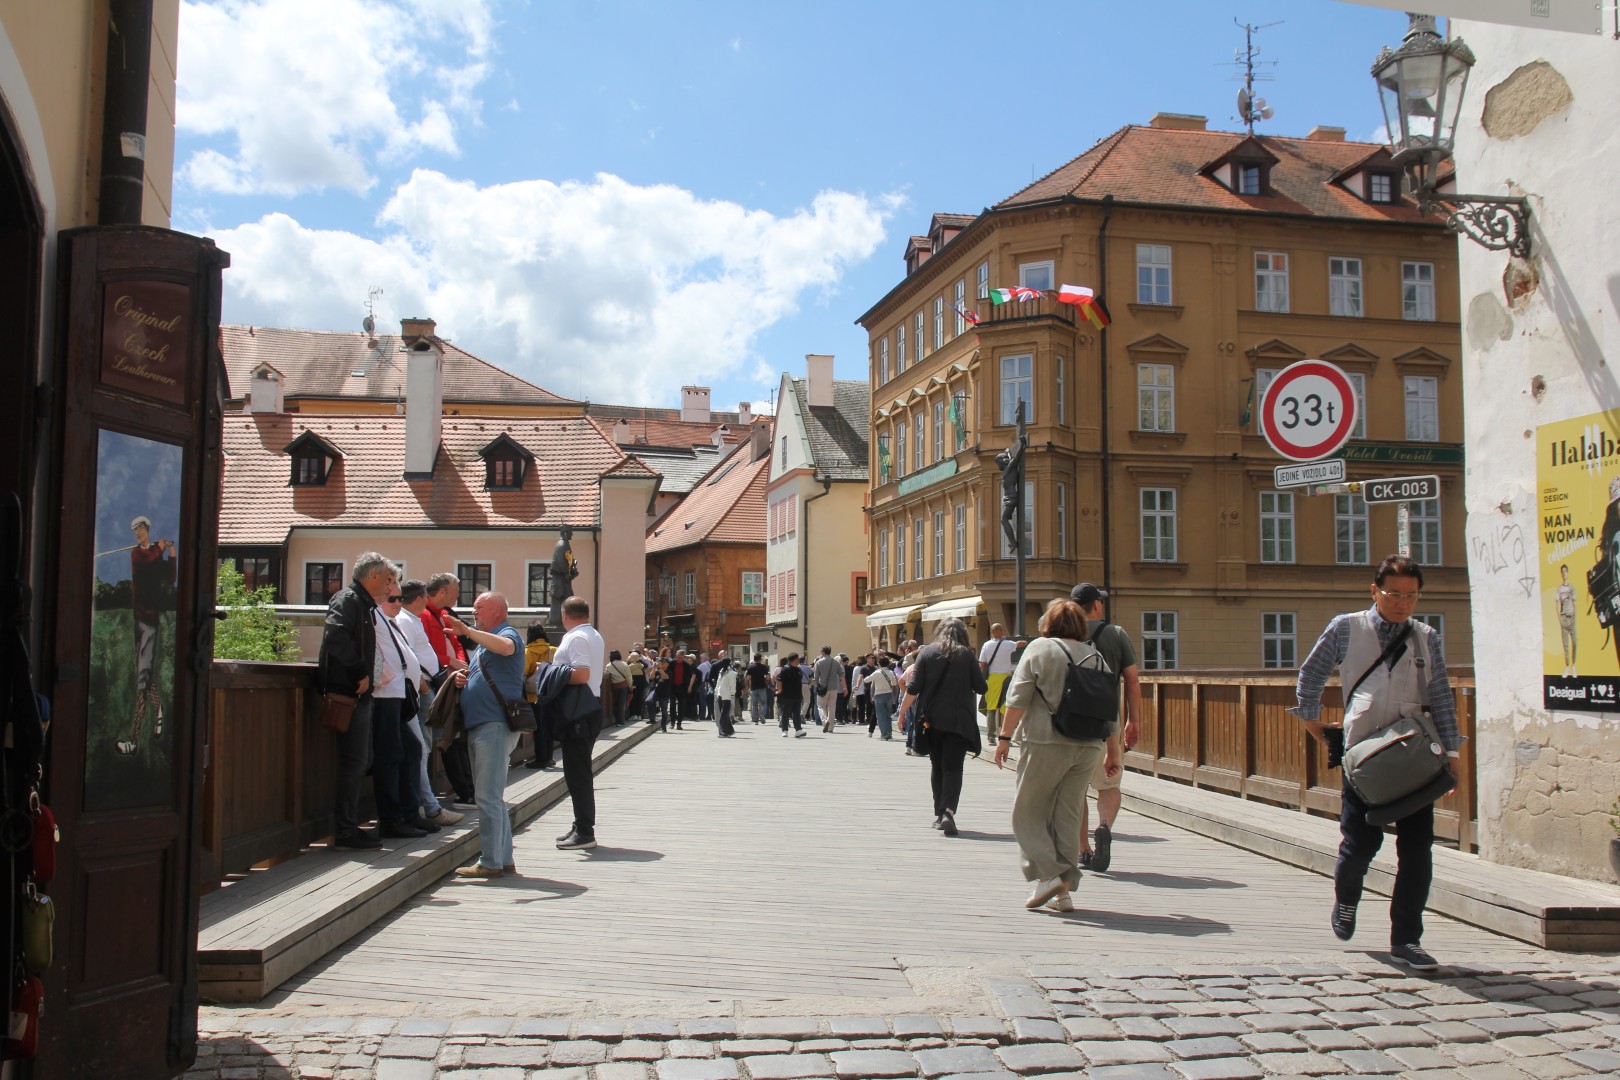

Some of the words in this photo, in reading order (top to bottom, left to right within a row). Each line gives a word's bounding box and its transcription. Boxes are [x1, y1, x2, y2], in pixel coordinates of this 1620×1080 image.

[114, 295, 182, 333] Original
[123, 330, 170, 363] Czech
[111, 354, 177, 386] Leatherware
[1281, 394, 1335, 429] 33t
[1342, 447, 1378, 460] Hotel
[1279, 468, 1300, 483] JEDINÉ
[1302, 466, 1327, 480] VOZIDLO
[1372, 481, 1429, 499] CK-003
[1544, 493, 1569, 503] DESIGN
[1544, 513, 1572, 528] MAN
[1544, 526, 1594, 544] WOMAN
[1549, 685, 1586, 700] Desigual
